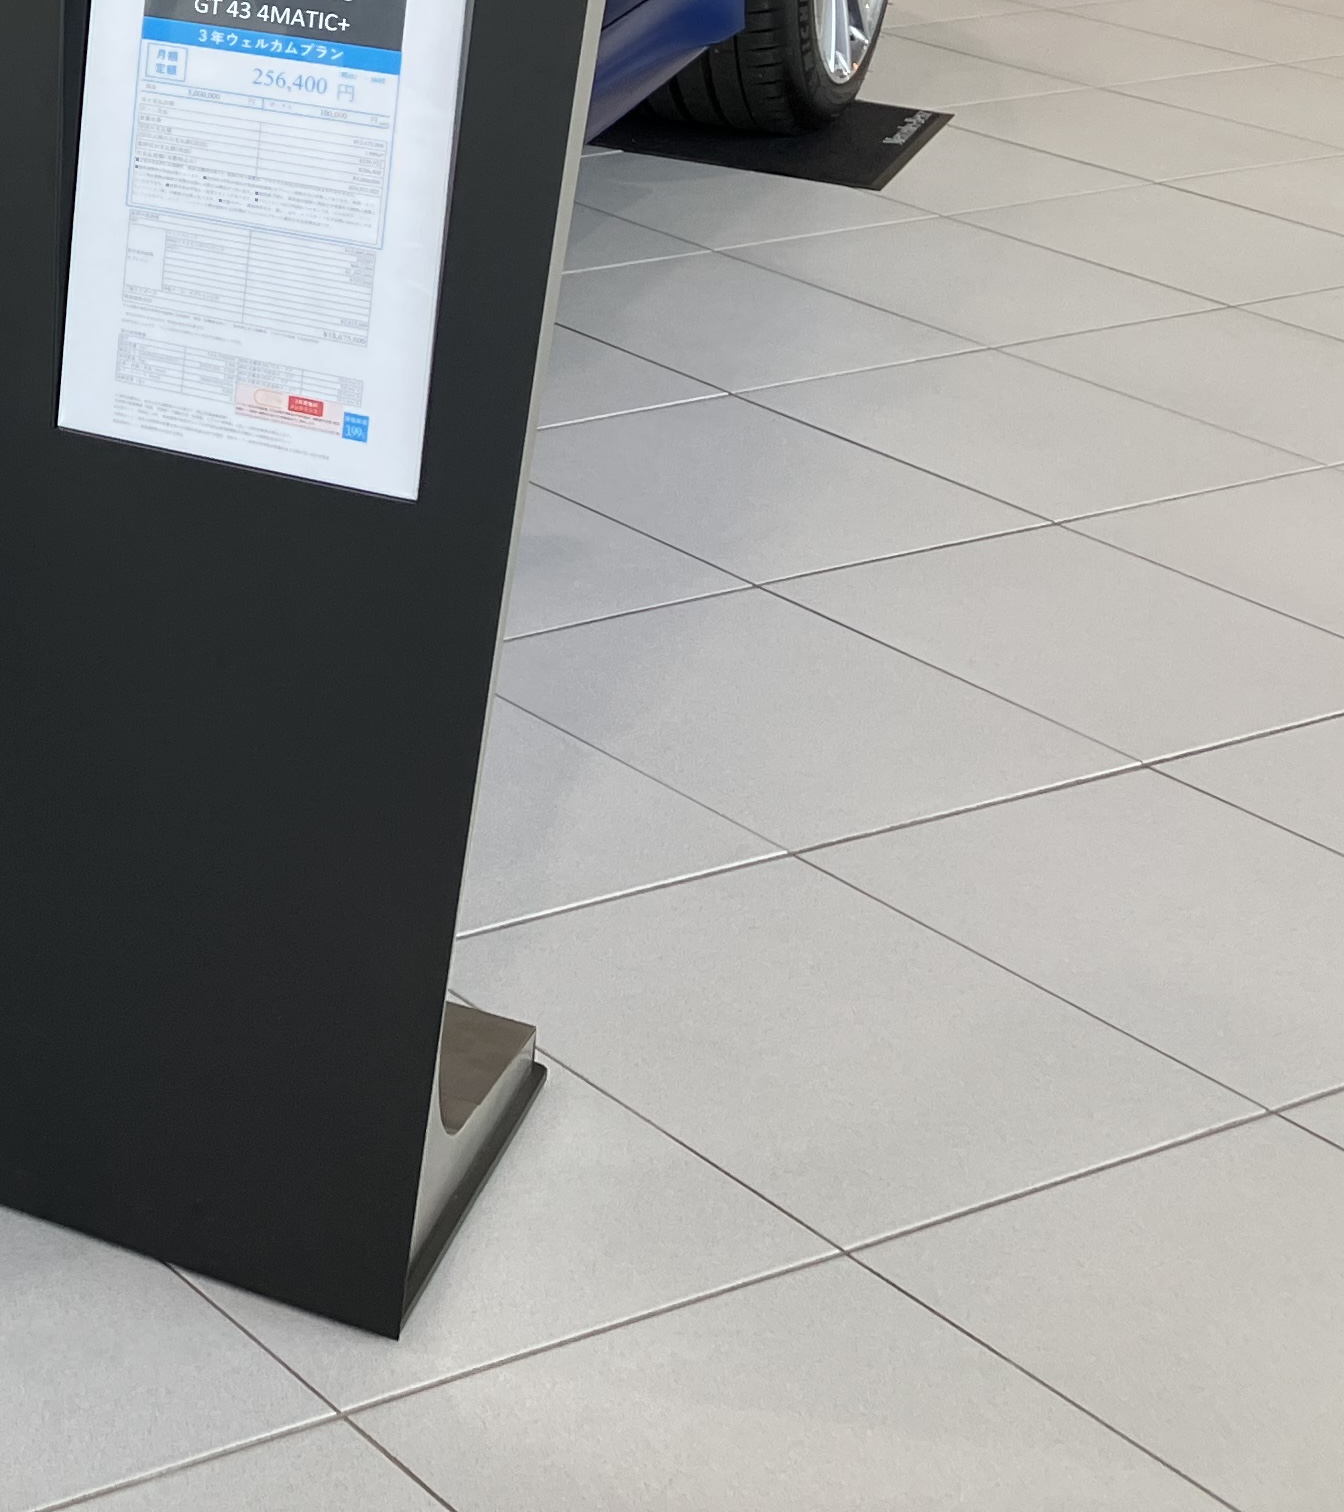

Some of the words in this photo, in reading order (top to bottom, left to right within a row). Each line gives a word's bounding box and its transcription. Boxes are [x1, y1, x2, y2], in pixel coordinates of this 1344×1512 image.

[225, 0, 251, 20] 43
[257, 4, 351, 32] 4MATIC+
[252, 68, 328, 95] 256,400
[336, 83, 356, 103] 円
